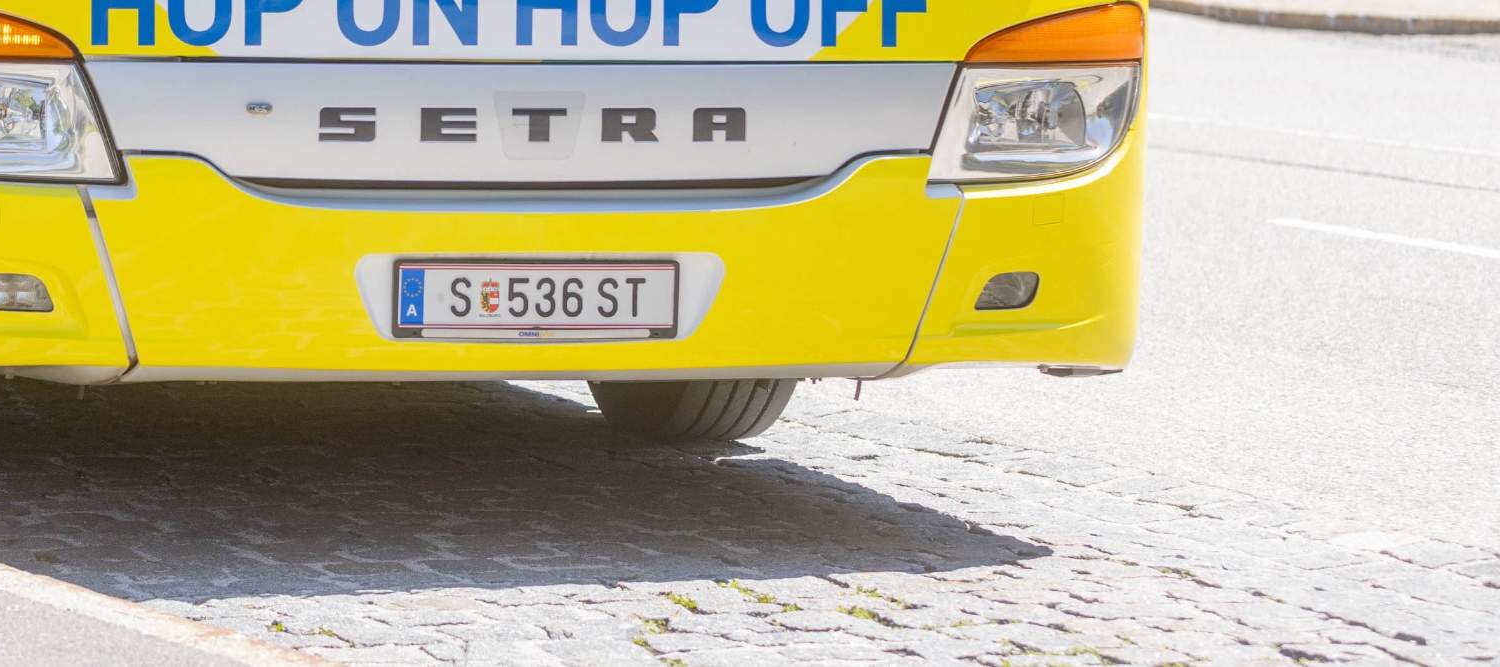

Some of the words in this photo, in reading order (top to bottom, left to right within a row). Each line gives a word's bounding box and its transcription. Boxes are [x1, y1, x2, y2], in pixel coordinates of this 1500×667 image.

[318, 107, 746, 142] SETRA
[406, 303, 418, 317] A
[450, 277, 472, 318] S
[508, 277, 584, 318] 536
[597, 277, 646, 318] ST
